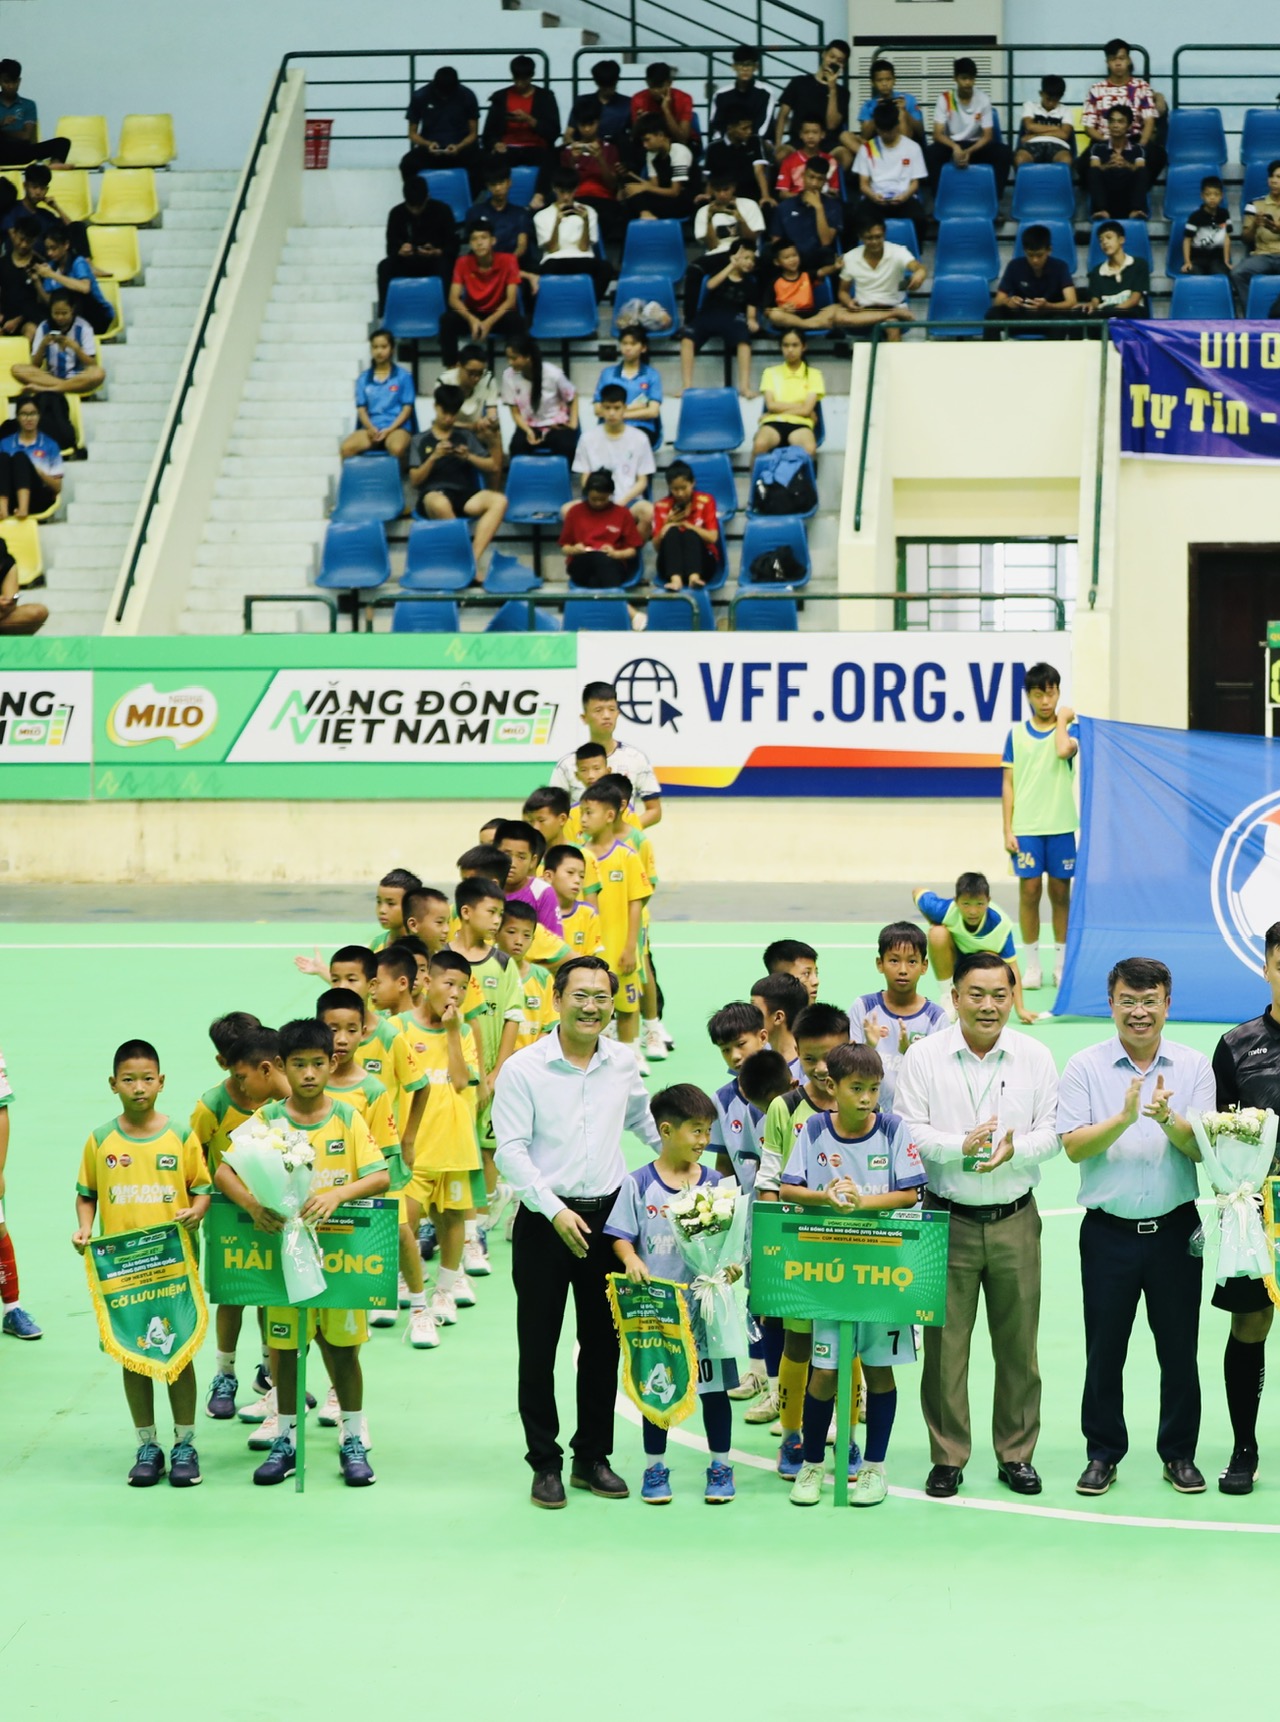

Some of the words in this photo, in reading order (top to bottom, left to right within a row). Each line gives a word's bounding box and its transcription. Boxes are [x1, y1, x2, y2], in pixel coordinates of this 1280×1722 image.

[1200, 331, 1250, 369] U11
[1129, 384, 1178, 439] Tự
[1185, 388, 1250, 436] Tin
[124, 705, 204, 728] MILO
[393, 718, 490, 744] NAM
[625, 984, 637, 1003] 5
[451, 1180, 462, 1202] 9
[224, 1241, 273, 1271] HẢI
[324, 1249, 384, 1275] ƠNG
[784, 1257, 845, 1284] PHÚ
[853, 1264, 914, 1293] THỌ
[110, 1294, 129, 1309] CỜ
[131, 1290, 155, 1305] LƯU
[157, 1282, 187, 1299] NIỆM
[887, 1330, 901, 1356] 7
